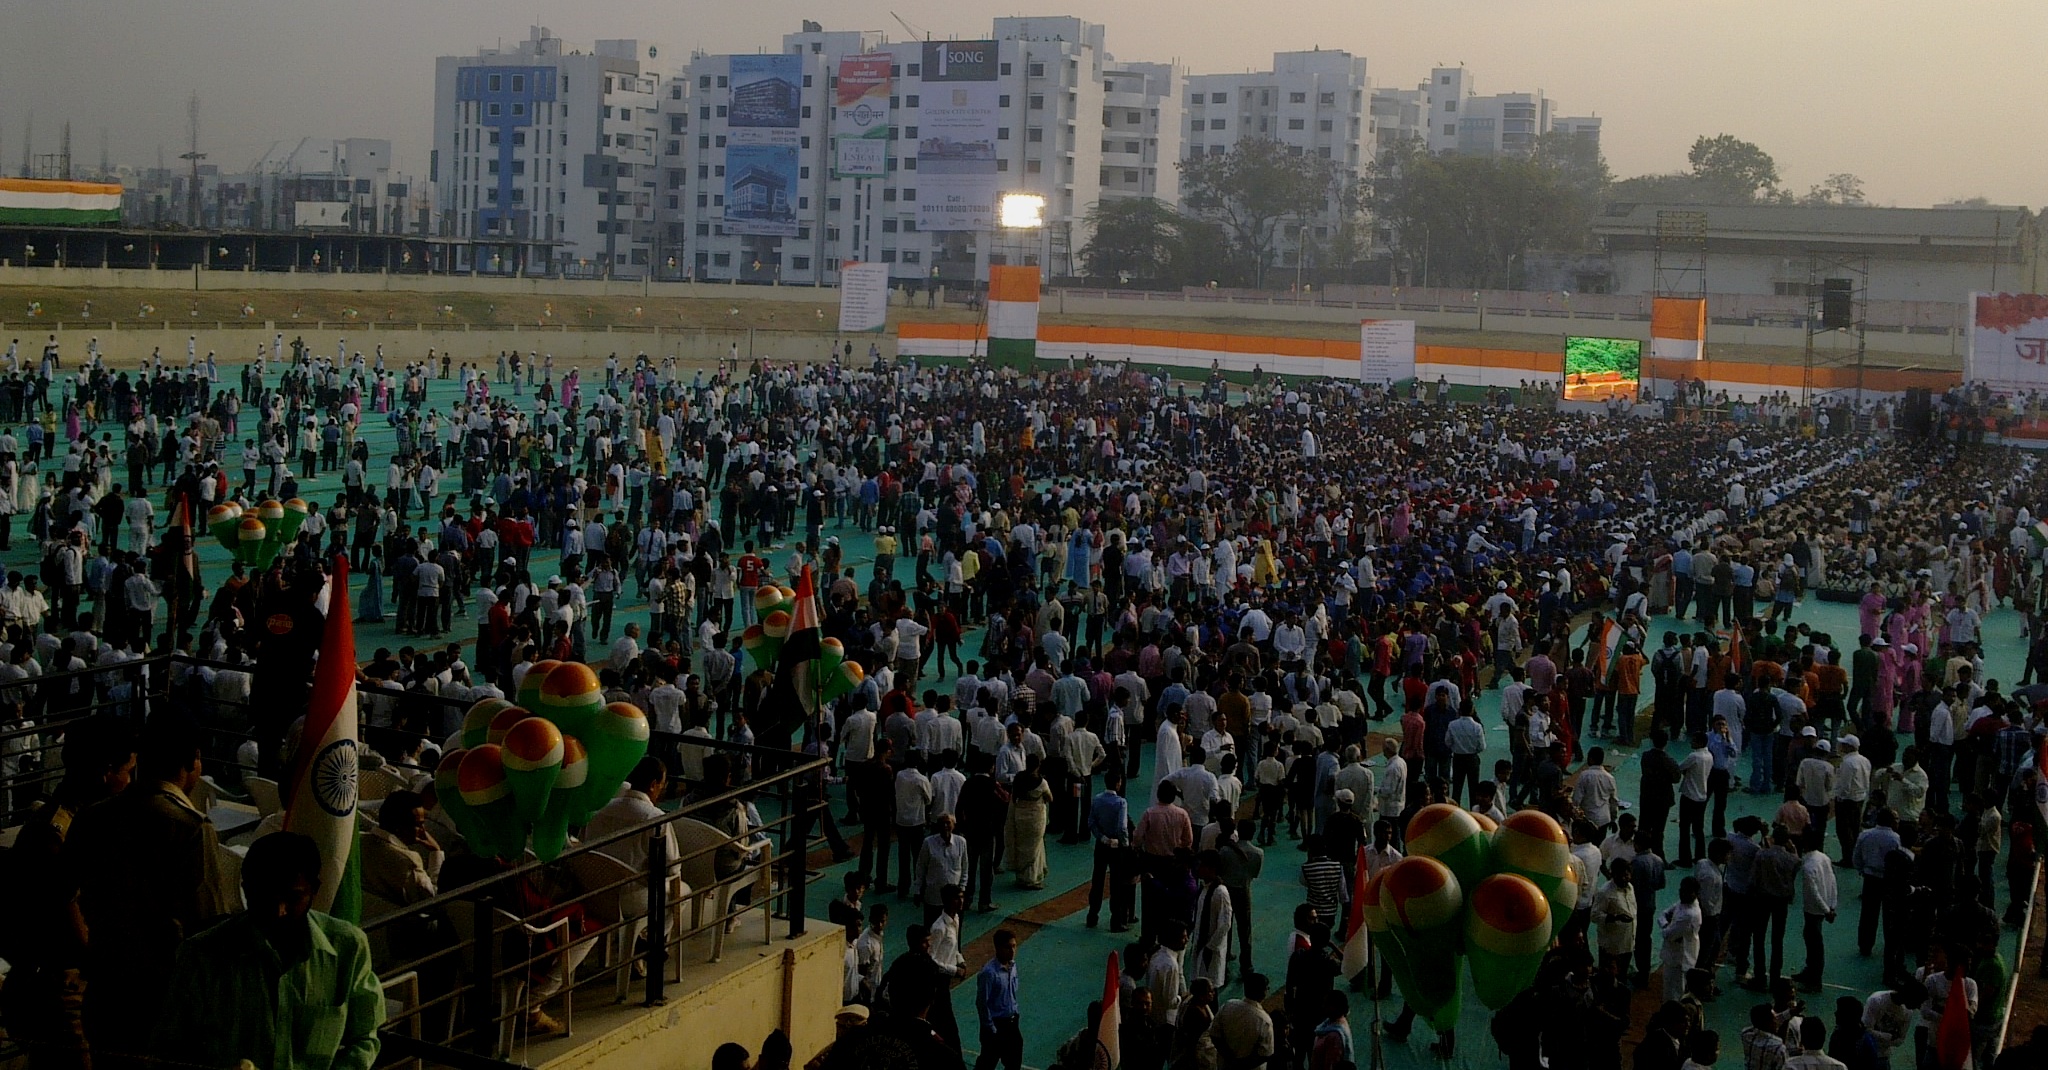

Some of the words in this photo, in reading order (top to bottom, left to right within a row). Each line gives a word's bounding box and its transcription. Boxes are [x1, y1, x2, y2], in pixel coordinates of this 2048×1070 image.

[936, 43, 948, 76] 1
[948, 51, 984, 63] SONG
[2015, 337, 2048, 365] ज
[746, 559, 755, 571] 5
